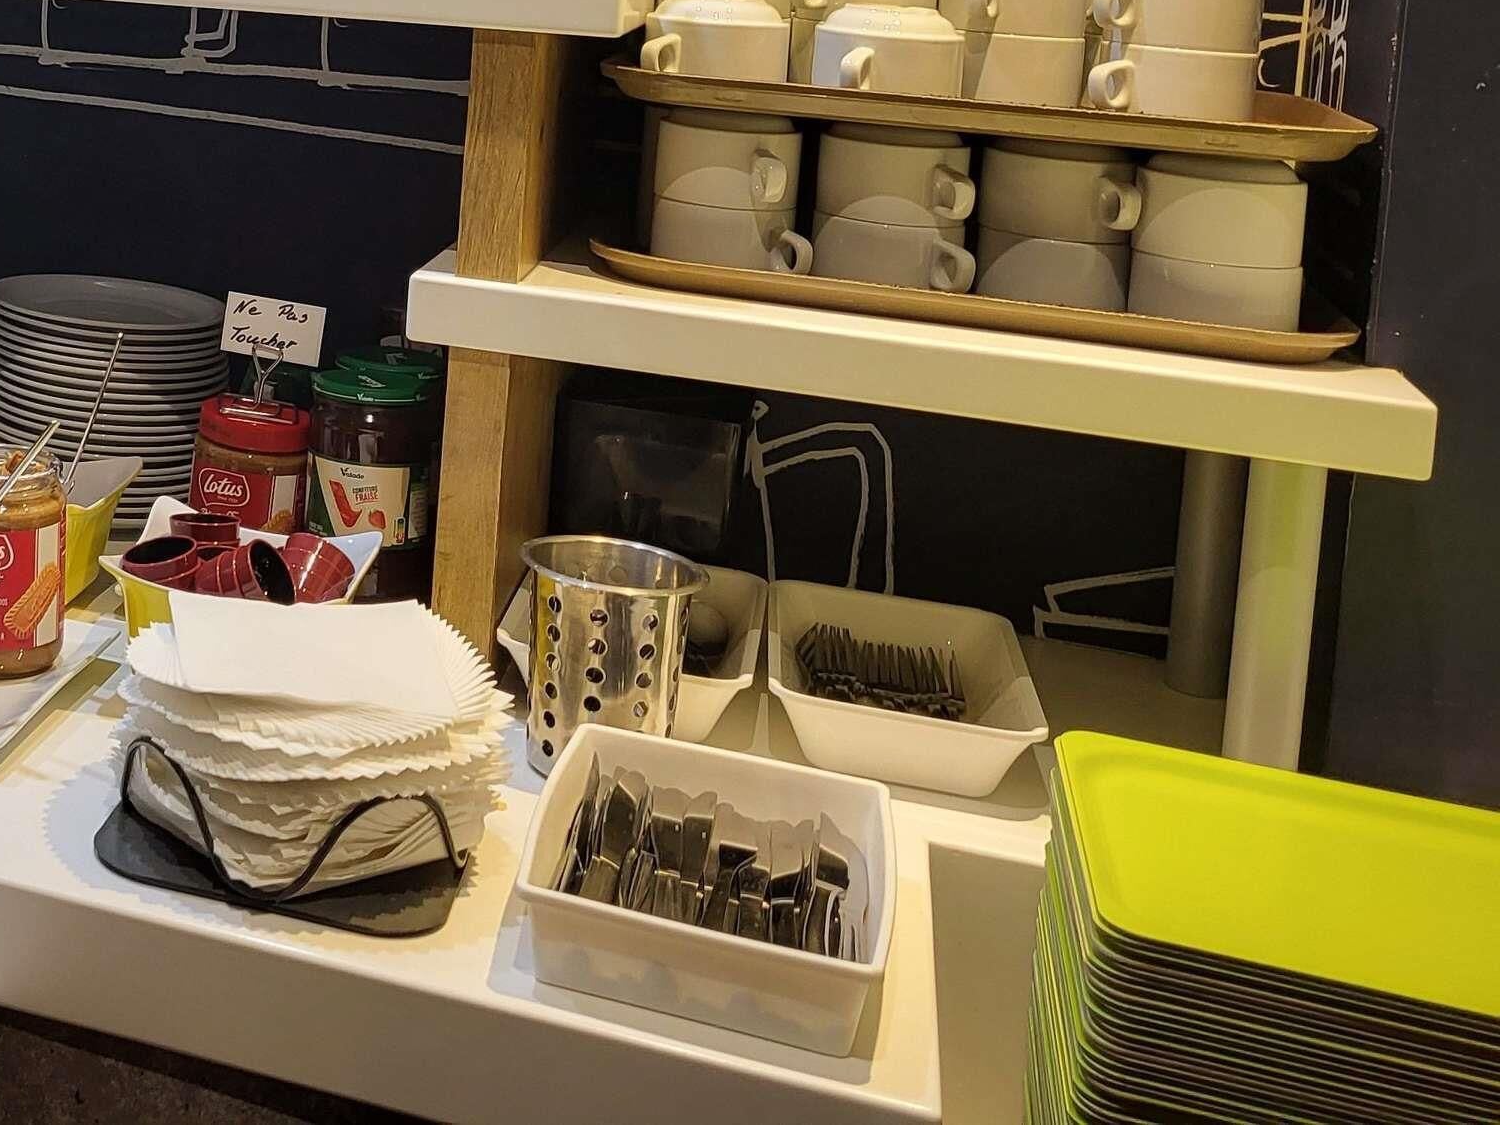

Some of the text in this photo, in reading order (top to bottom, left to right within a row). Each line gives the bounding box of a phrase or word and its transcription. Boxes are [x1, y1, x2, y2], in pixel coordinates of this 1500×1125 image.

[233, 298, 308, 324] Ne Pas
[230, 325, 299, 351] Toucher
[354, 490, 379, 503] FRAISE
